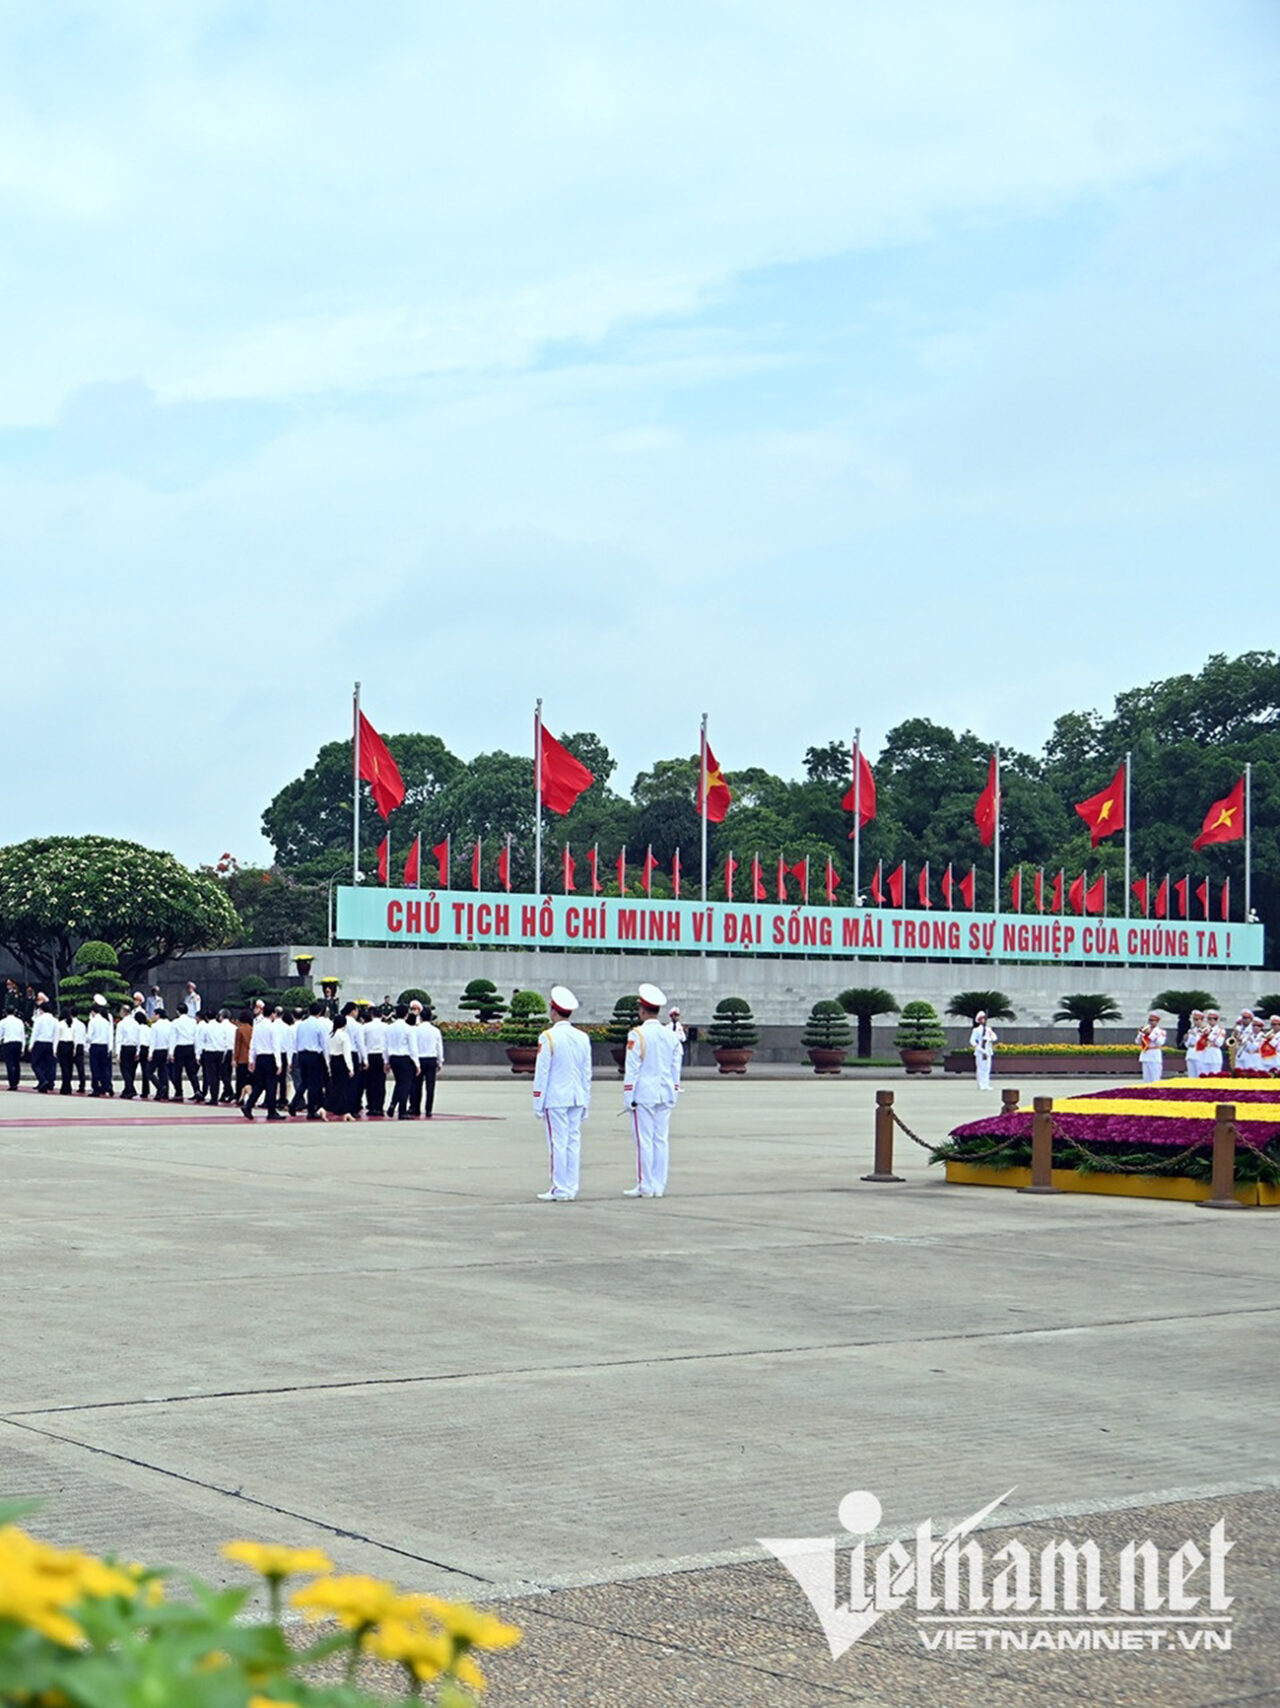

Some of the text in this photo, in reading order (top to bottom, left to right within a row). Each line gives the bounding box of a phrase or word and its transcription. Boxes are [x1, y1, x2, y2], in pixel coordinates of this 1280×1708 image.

[387, 891, 440, 934] CHỦ
[452, 902, 509, 941] TỊCH
[522, 895, 554, 938] HỒ
[565, 901, 606, 939] CHÍ
[617, 909, 680, 942] MINH
[692, 907, 713, 943] VĨ
[723, 912, 761, 949] ĐẠI
[772, 905, 832, 947] SỐNG
[842, 913, 883, 948] MÃI
[892, 919, 960, 950] TRONG
[969, 919, 996, 956] SỰ
[1003, 920, 1075, 958] NGHIỆP
[1082, 919, 1119, 955] CỦA
[1127, 924, 1189, 957] CHÚNG
[1196, 930, 1218, 958] TA
